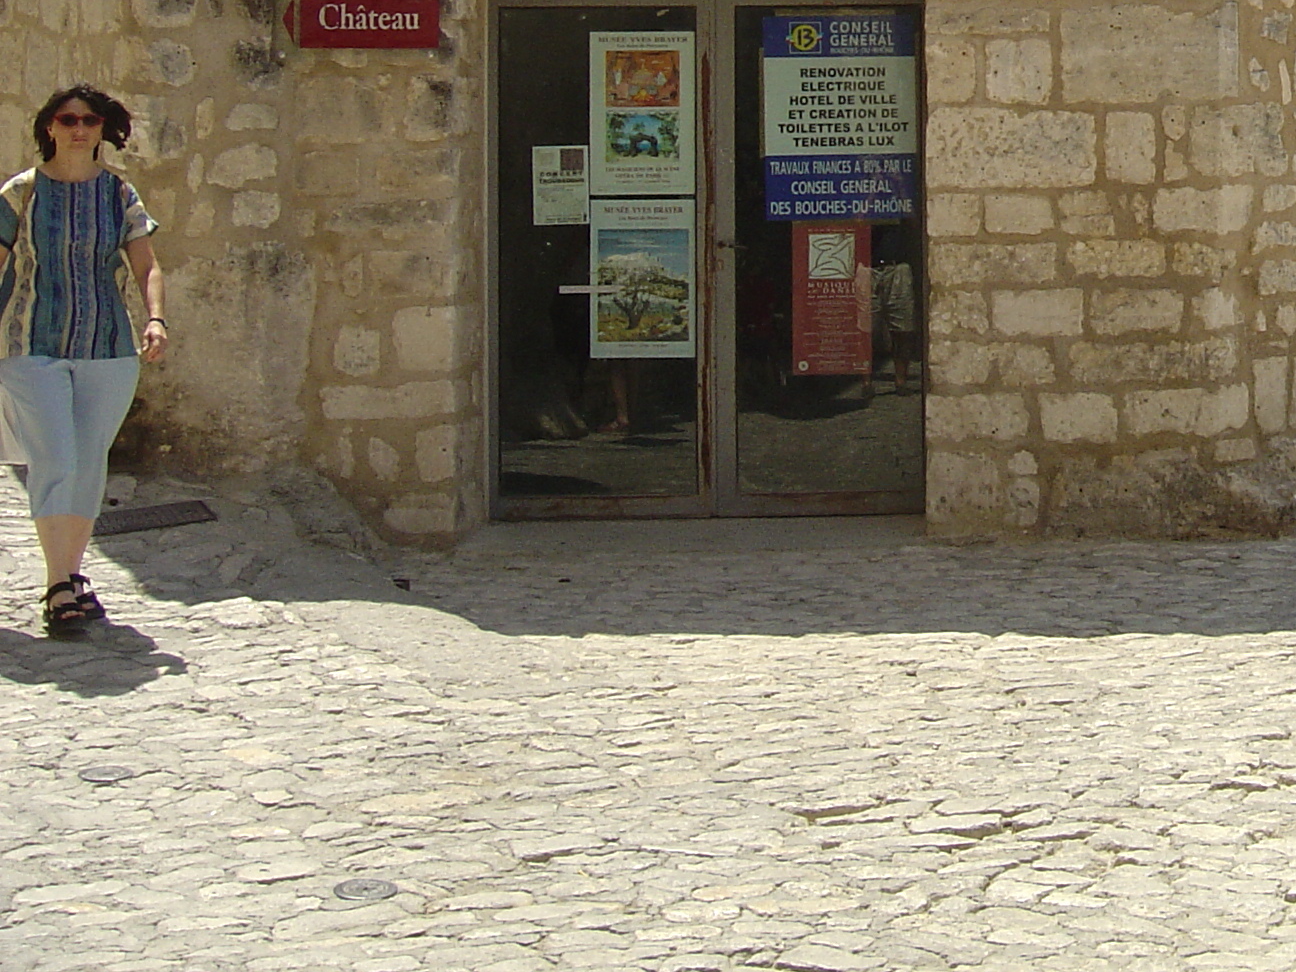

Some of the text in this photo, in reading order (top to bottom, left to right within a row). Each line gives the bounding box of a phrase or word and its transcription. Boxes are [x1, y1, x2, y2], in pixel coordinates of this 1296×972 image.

[318, 3, 420, 30] Château
[829, 21, 893, 34] CONSEIL
[829, 33, 895, 47] GENERAL
[800, 67, 886, 78] RENOVATION
[801, 81, 885, 92] ELECTRIQUE
[789, 94, 897, 106] HOTEL DE VILLE
[788, 108, 898, 120] ET CREATION DE
[778, 122, 909, 134] TOILETTES A L'ILOT
[793, 136, 895, 147] TENEBRAS LUX
[770, 161, 809, 175] TRAVAUX
[812, 160, 852, 174] FINANCES
[854, 160, 862, 173] A
[883, 159, 900, 172] PAR
[902, 159, 912, 172] LE
[790, 180, 892, 195] CONSEIL GENERAL
[770, 199, 912, 215] DES BOUCHES-DU-RHÔNE
